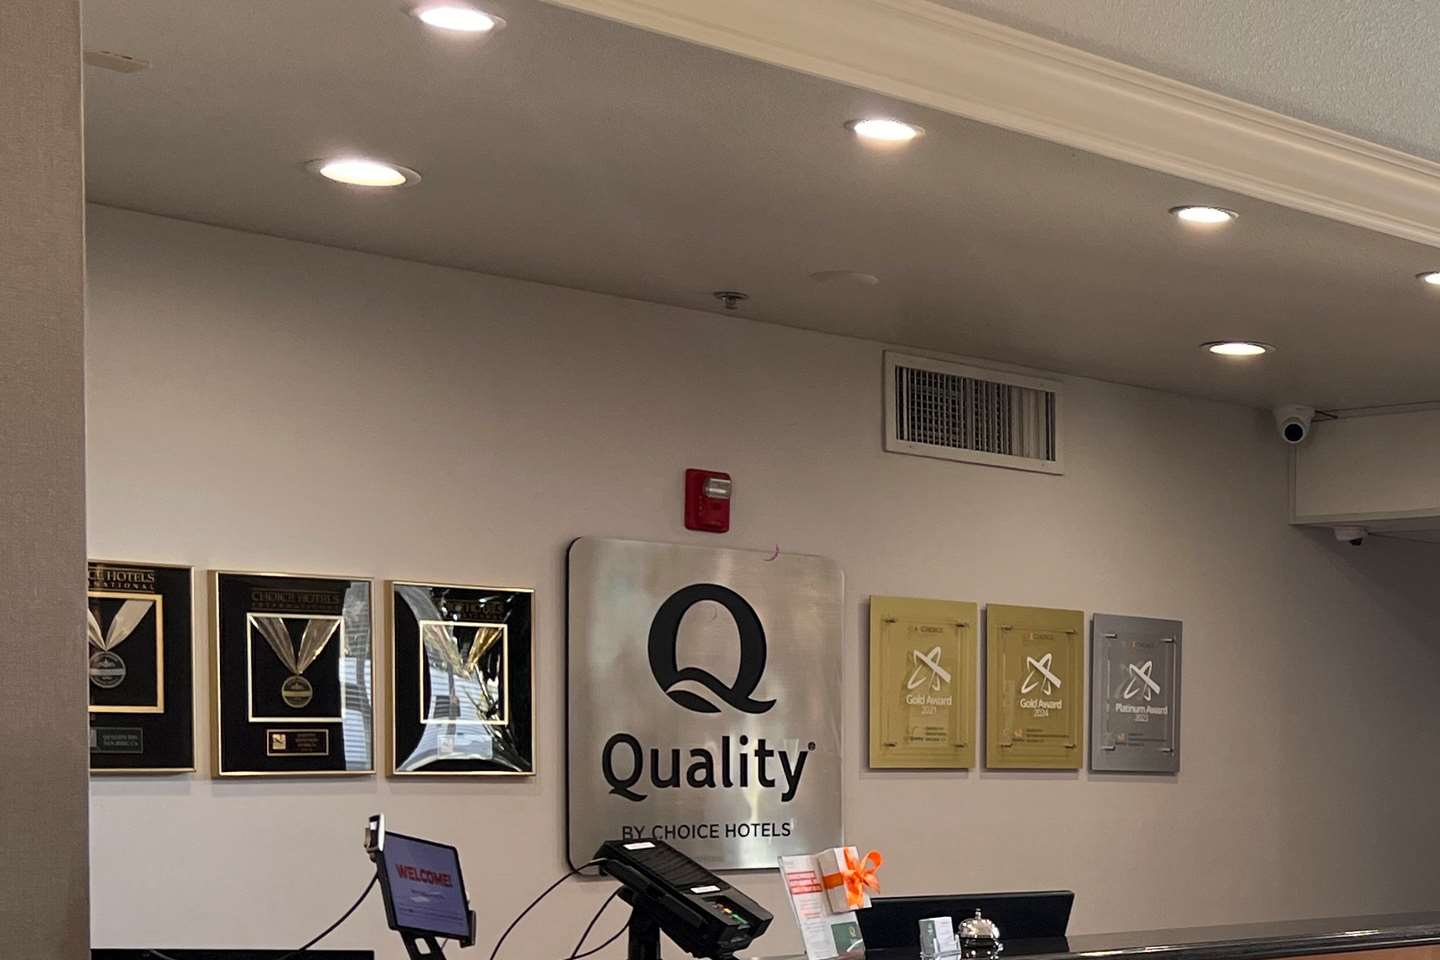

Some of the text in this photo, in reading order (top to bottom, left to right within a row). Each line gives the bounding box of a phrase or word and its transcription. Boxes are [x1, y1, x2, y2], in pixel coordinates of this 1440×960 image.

[106, 570, 155, 583] HOTELS
[648, 583, 777, 714] Q
[906, 694, 953, 706] Gold Award
[1020, 698, 1063, 710] Gold Award
[1115, 703, 1169, 715] Platinum Award
[622, 822, 791, 840] BY CHOICE HOTELS
